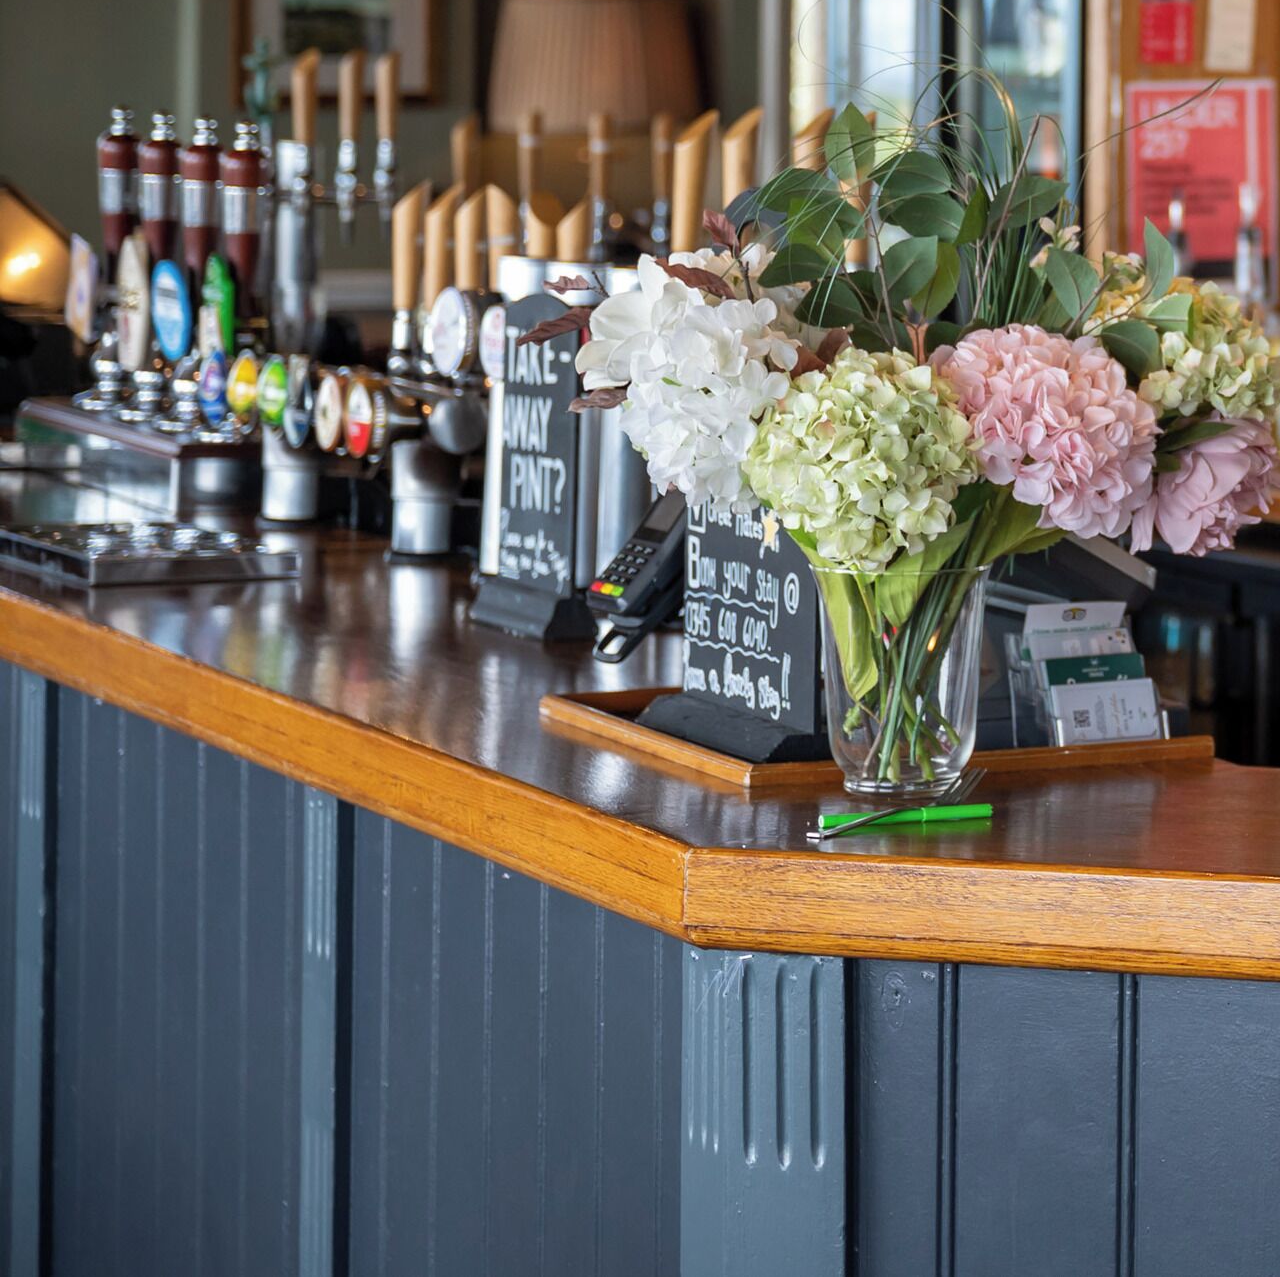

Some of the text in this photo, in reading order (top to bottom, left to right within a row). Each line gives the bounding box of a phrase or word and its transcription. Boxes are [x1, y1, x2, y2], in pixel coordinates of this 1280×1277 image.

[503, 394, 553, 453] AWAY
[510, 456, 566, 515] PINT?
[784, 573, 800, 614] @
